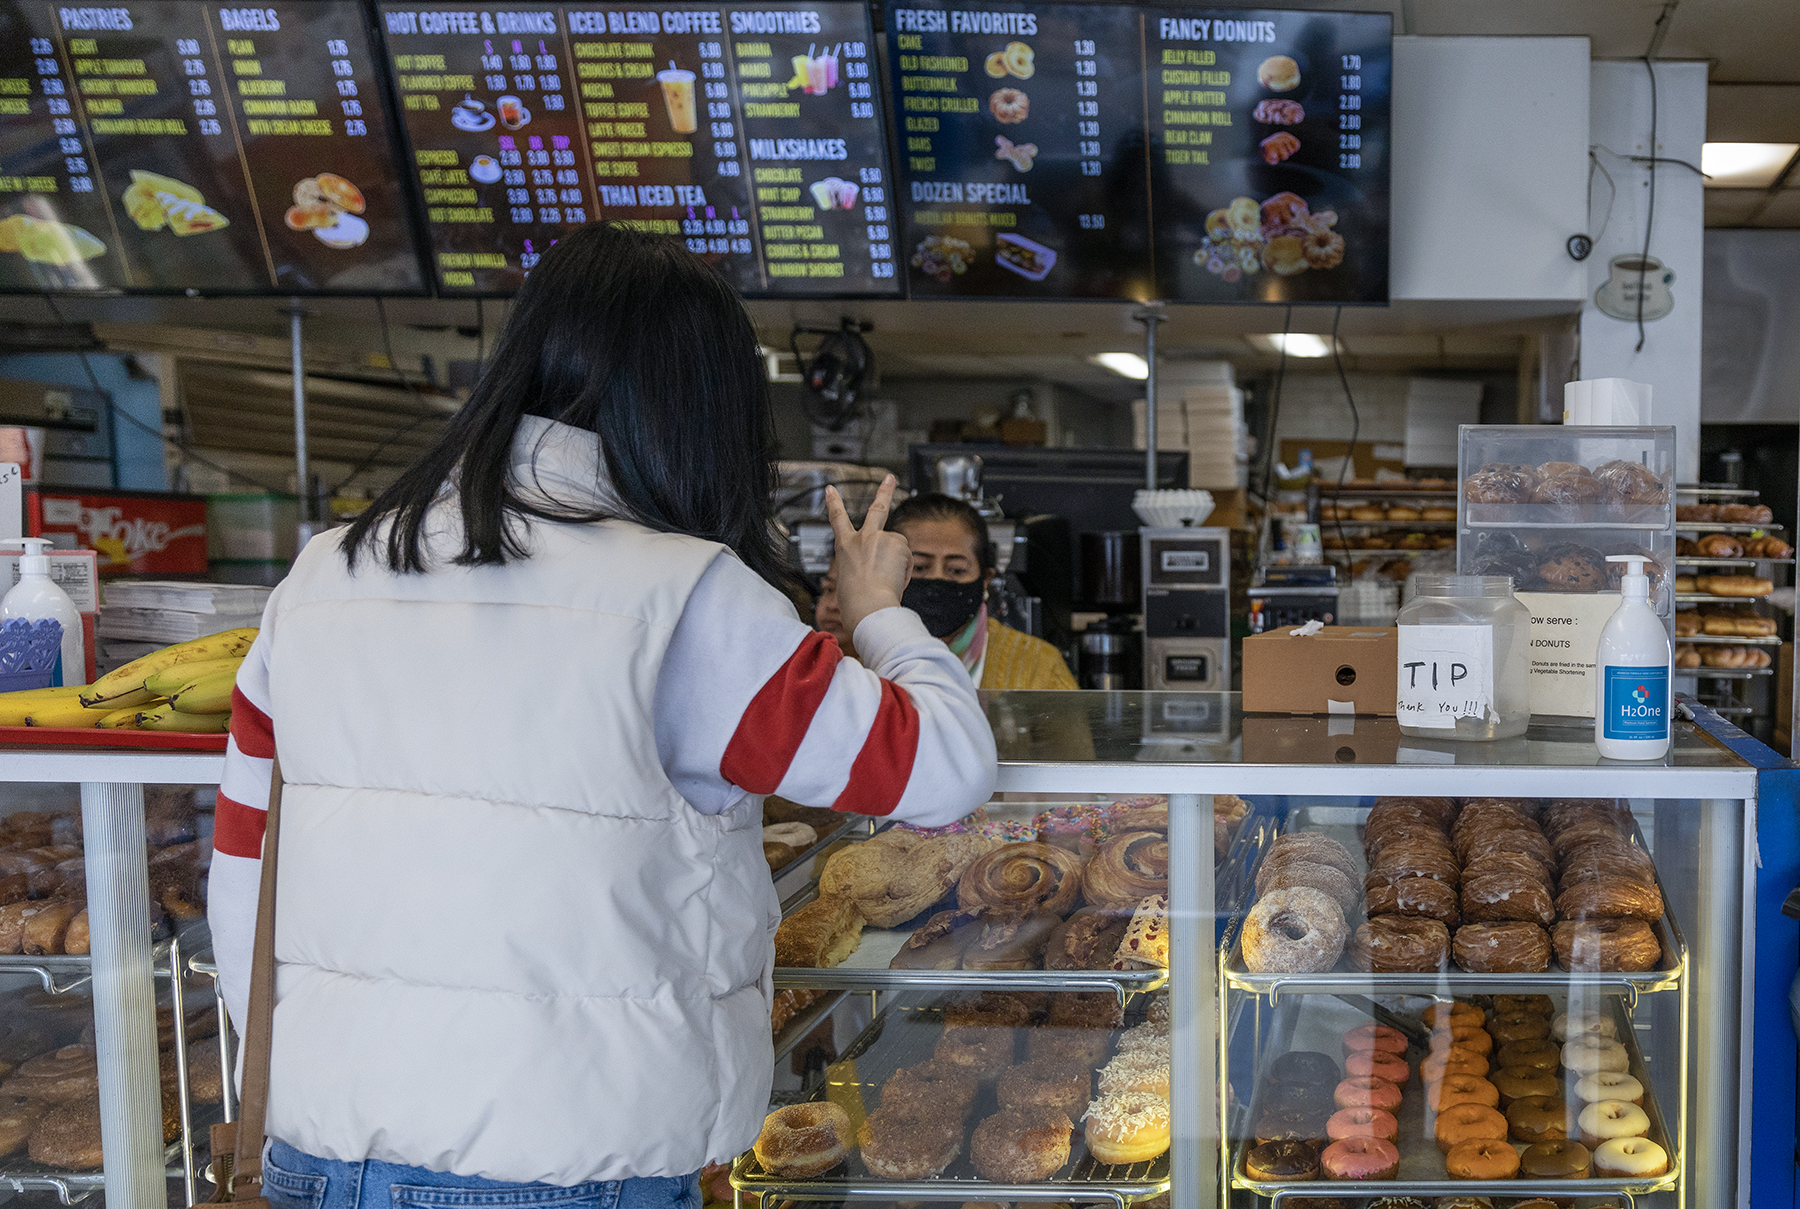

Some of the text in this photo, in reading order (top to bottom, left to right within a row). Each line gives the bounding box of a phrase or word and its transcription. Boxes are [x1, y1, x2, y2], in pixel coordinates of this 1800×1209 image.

[59, 8, 133, 30] PASTRIES
[220, 8, 280, 31] BAGELS
[385, 12, 556, 34] HOT COFFEE & DRINKS
[568, 12, 722, 34] ICED BLEND COFFEE
[730, 12, 821, 33] SMOOTHIES
[896, 9, 1038, 36] FRESH FAVORITES
[1160, 18, 1276, 43] FANCY DONUTS
[484, 39, 493, 55] S
[538, 39, 548, 55] L
[1342, 55, 1361, 71] 1.70
[1341, 75, 1361, 90] 1.80
[1339, 95, 1361, 110] 2.00
[1339, 115, 1361, 130] 2.00
[750, 138, 848, 161] MILKSHAKES
[1339, 134, 1361, 150] 2.00
[1339, 154, 1361, 169] 2.00
[598, 185, 707, 207] THAI ICED TEA
[911, 182, 1031, 205] DOZEN SPECIAL
[687, 205, 695, 220] S
[731, 205, 740, 220] L
[1536, 640, 1570, 648] DONUTS
[1404, 662, 1468, 691] TIP
[1398, 700, 1424, 712] Thank
[1438, 702, 1458, 713] You
[1621, 705, 1661, 717] H2One
